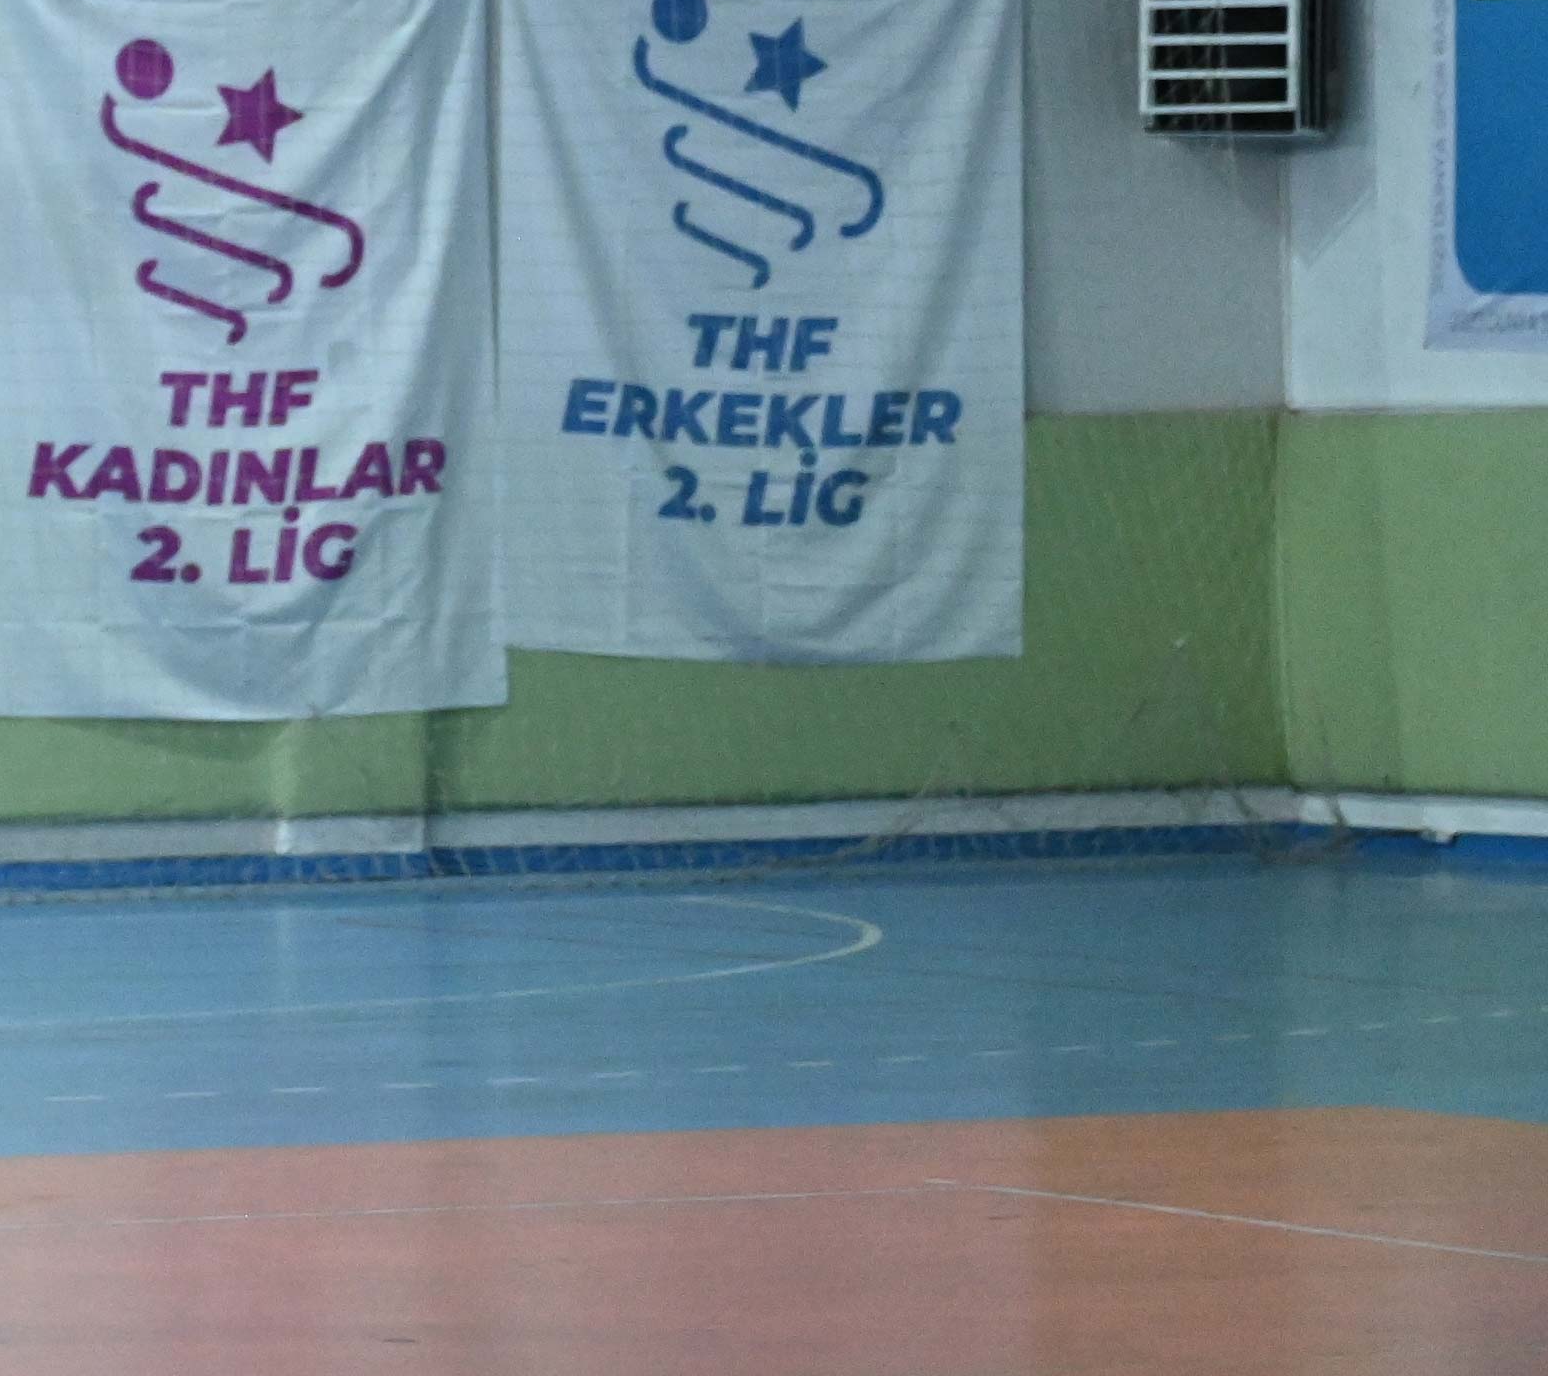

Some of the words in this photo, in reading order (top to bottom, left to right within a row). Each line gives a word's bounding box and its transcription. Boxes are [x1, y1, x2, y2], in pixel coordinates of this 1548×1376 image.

[687, 313, 839, 372] THF
[160, 369, 320, 427] THF
[561, 378, 963, 449] ERKEKLER
[27, 438, 447, 506] KADINLAR
[658, 465, 717, 523] 2.
[741, 447, 871, 526] LİG
[130, 524, 202, 583] 2.
[228, 505, 360, 584] LİG
